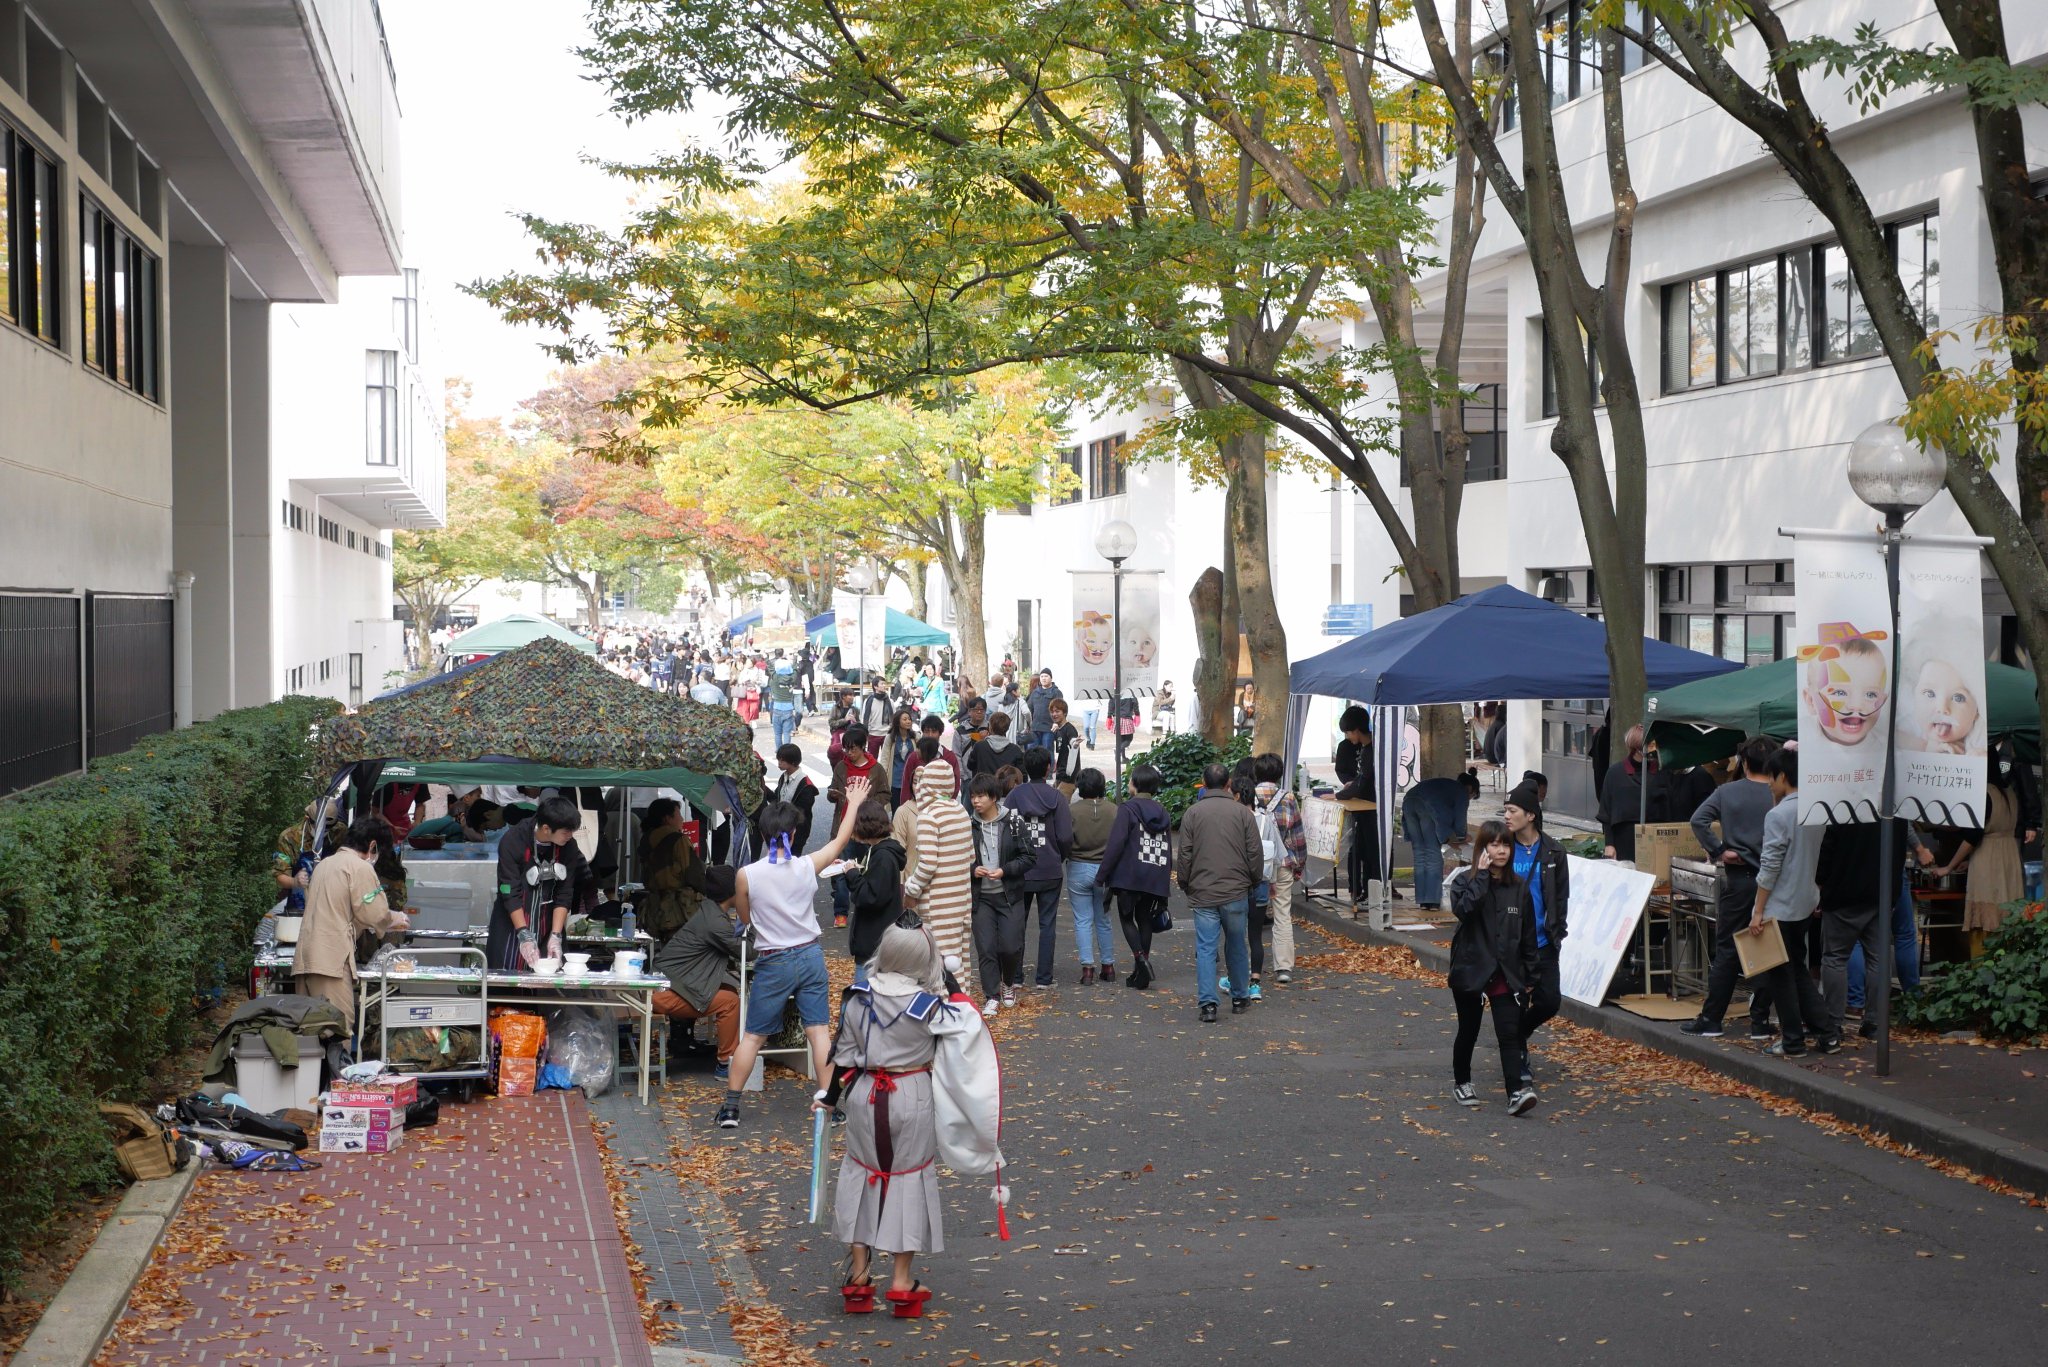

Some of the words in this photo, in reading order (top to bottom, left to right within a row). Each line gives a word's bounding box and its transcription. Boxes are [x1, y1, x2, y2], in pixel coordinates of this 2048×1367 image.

[1907, 771, 1972, 789] アートサイエンス学科
